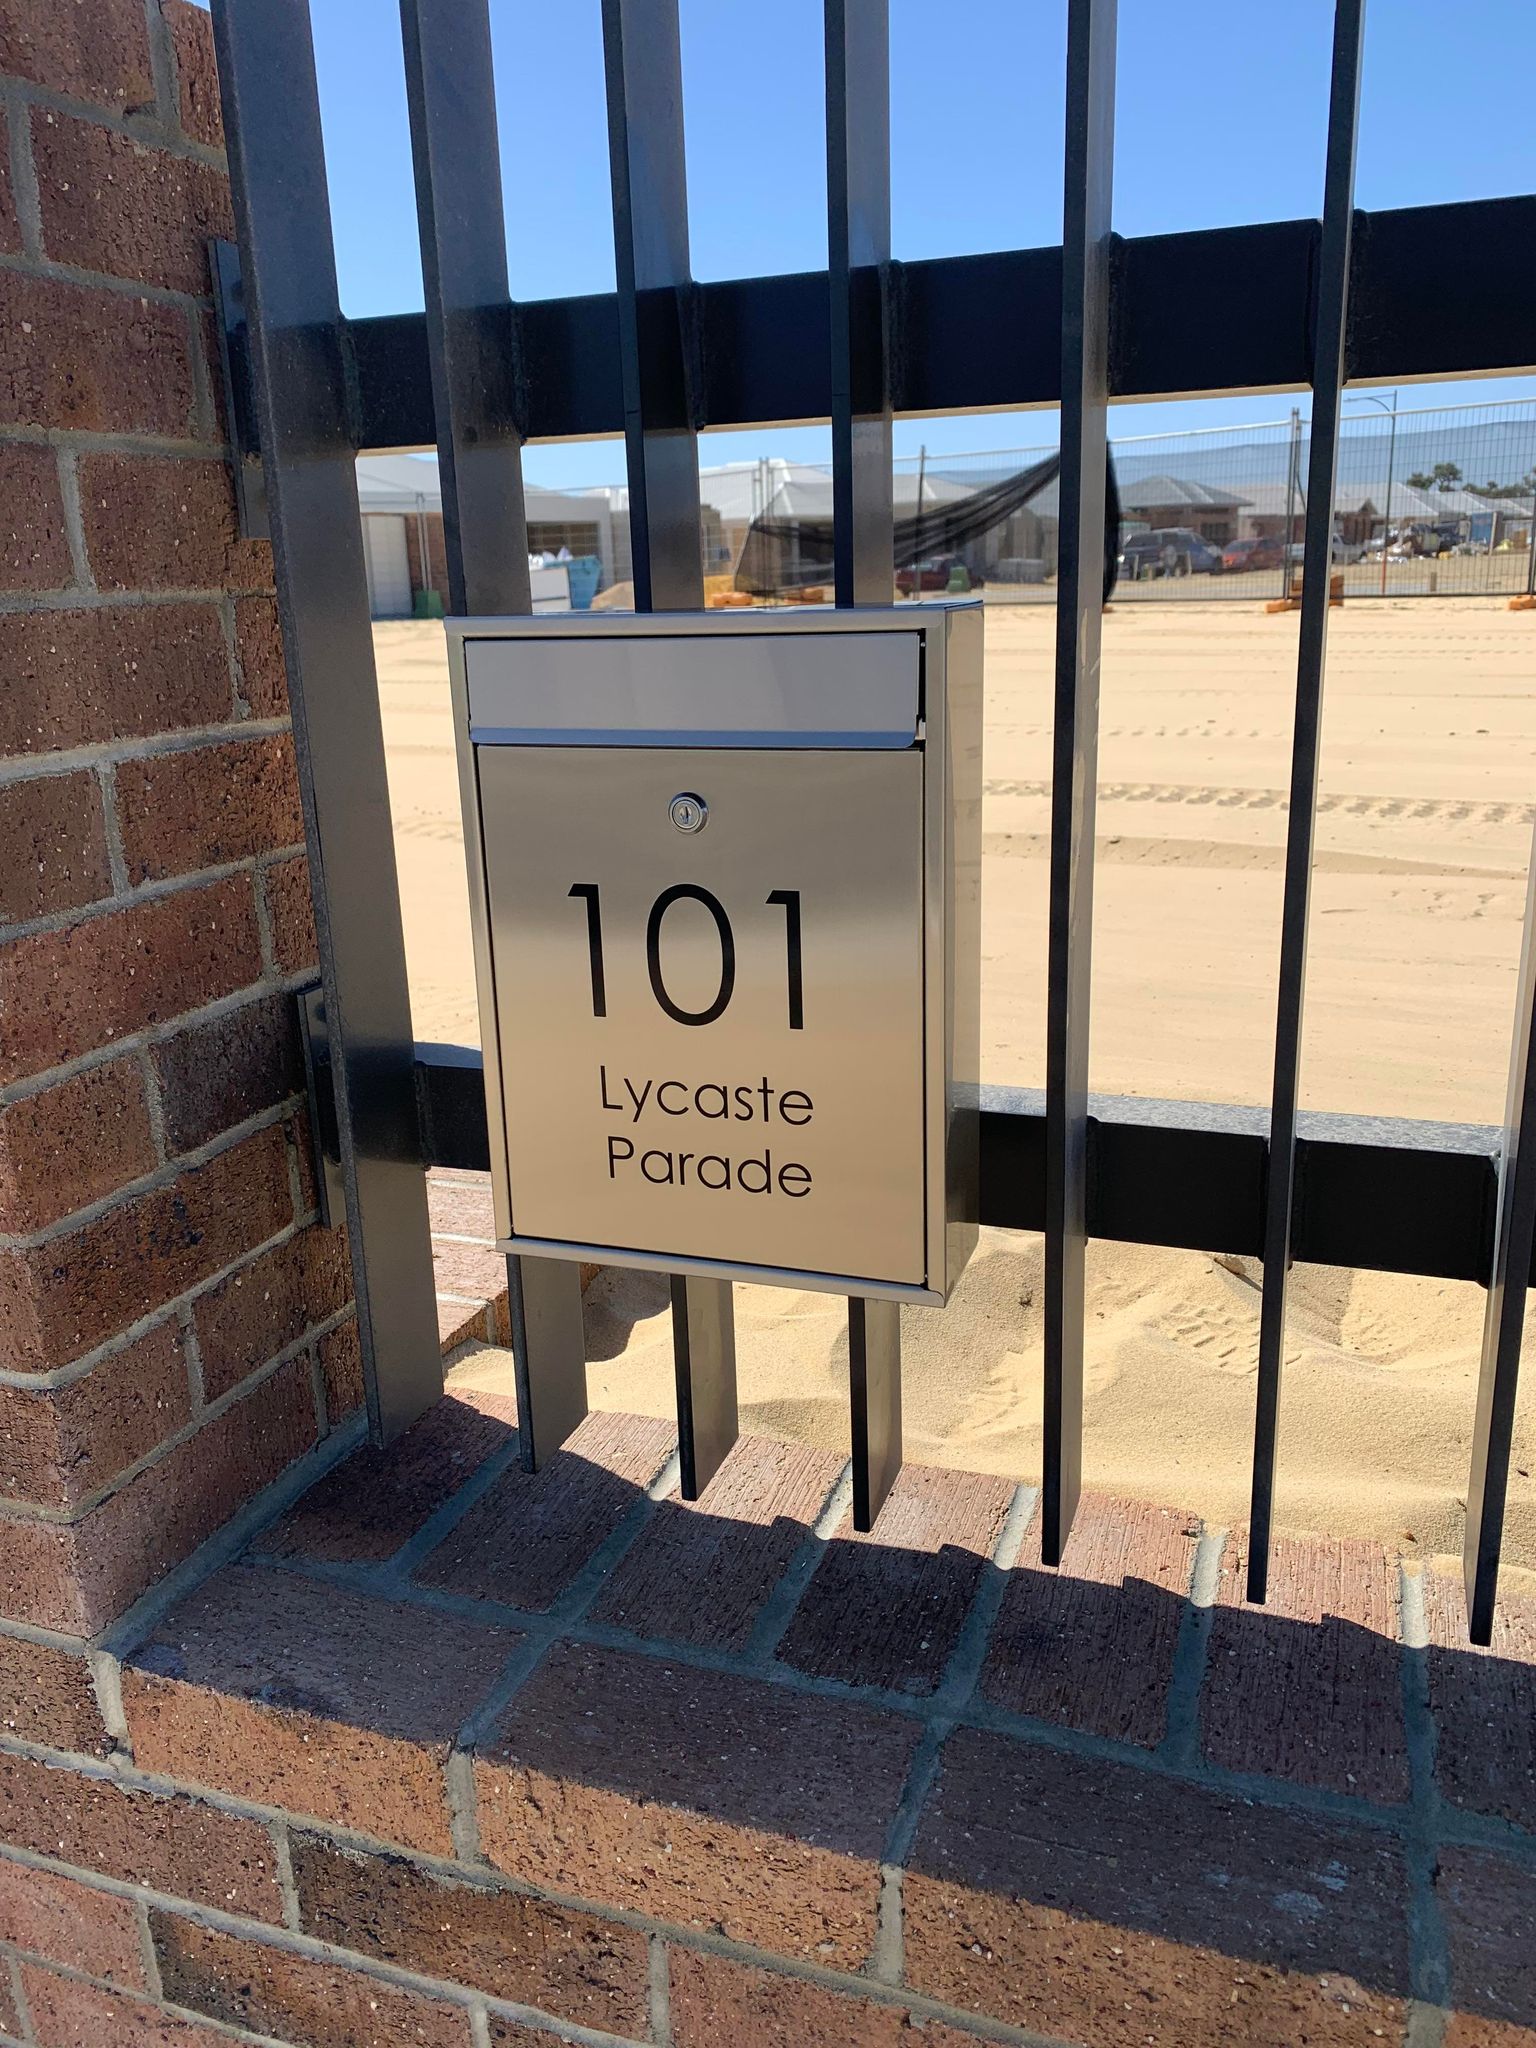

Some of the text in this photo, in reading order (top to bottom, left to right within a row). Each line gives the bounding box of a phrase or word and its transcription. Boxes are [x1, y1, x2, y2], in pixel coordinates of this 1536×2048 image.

[567, 883, 804, 1030] 101
[600, 1065, 814, 1126] Lycaste
[607, 1135, 813, 1198] Parade
